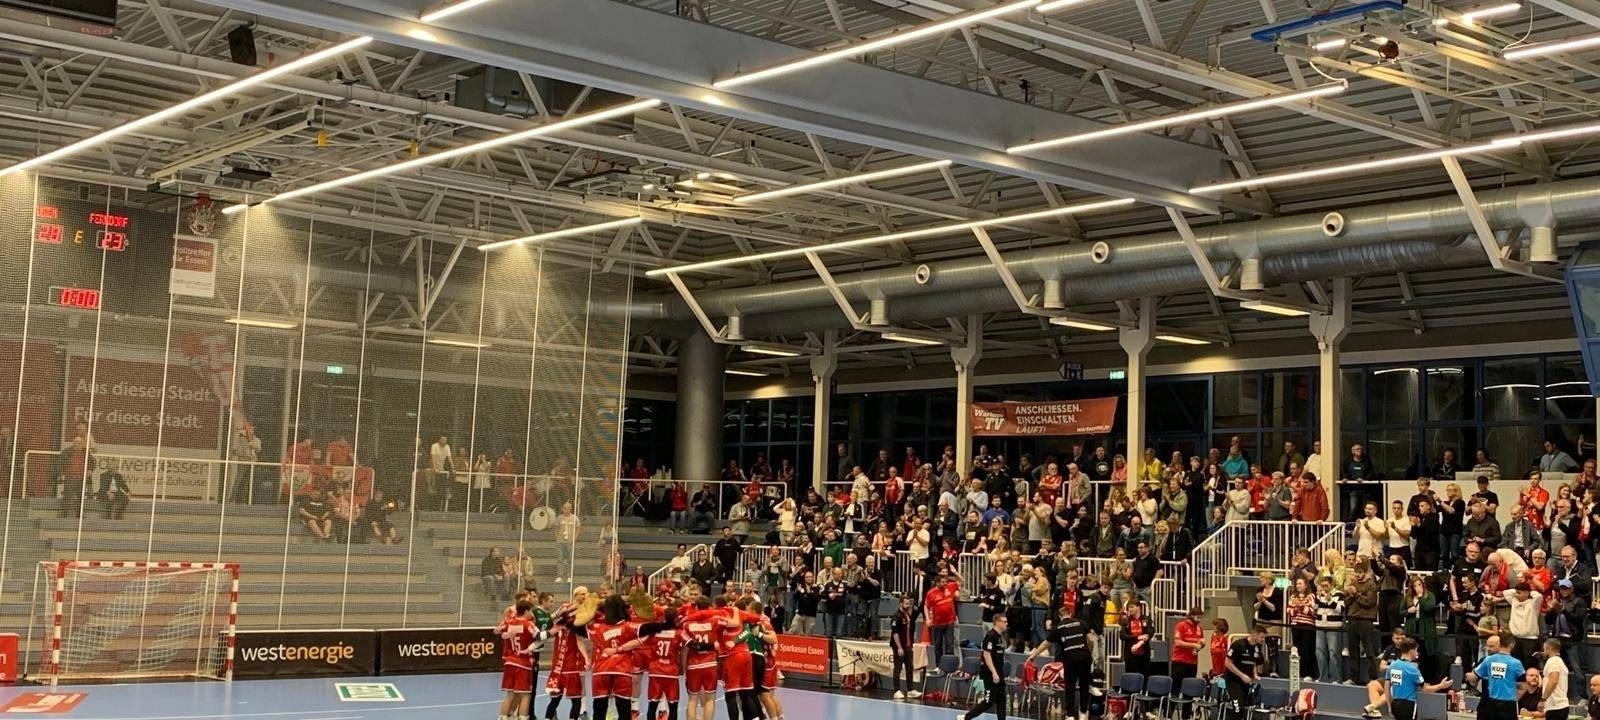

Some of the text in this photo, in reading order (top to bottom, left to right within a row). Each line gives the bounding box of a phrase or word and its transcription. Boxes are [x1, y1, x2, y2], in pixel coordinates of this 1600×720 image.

[89, 213, 129, 227] FERNDORF
[74, 229, 84, 243] E
[101, 232, 124, 249] 23
[174, 246, 212, 257] olltreffer
[76, 378, 108, 395] Aus
[112, 381, 162, 398] dieser
[1015, 404, 1082, 415] ANSCHLIESSEN.
[106, 410, 152, 427] diese
[985, 417, 1005, 431] TV
[1016, 415, 1078, 424] EINSCHALTEN.
[241, 641, 354, 664] westenergie
[398, 638, 494, 659] westenergie
[656, 640, 671, 657] 37
[780, 643, 825, 656] Sparkasse Essen
